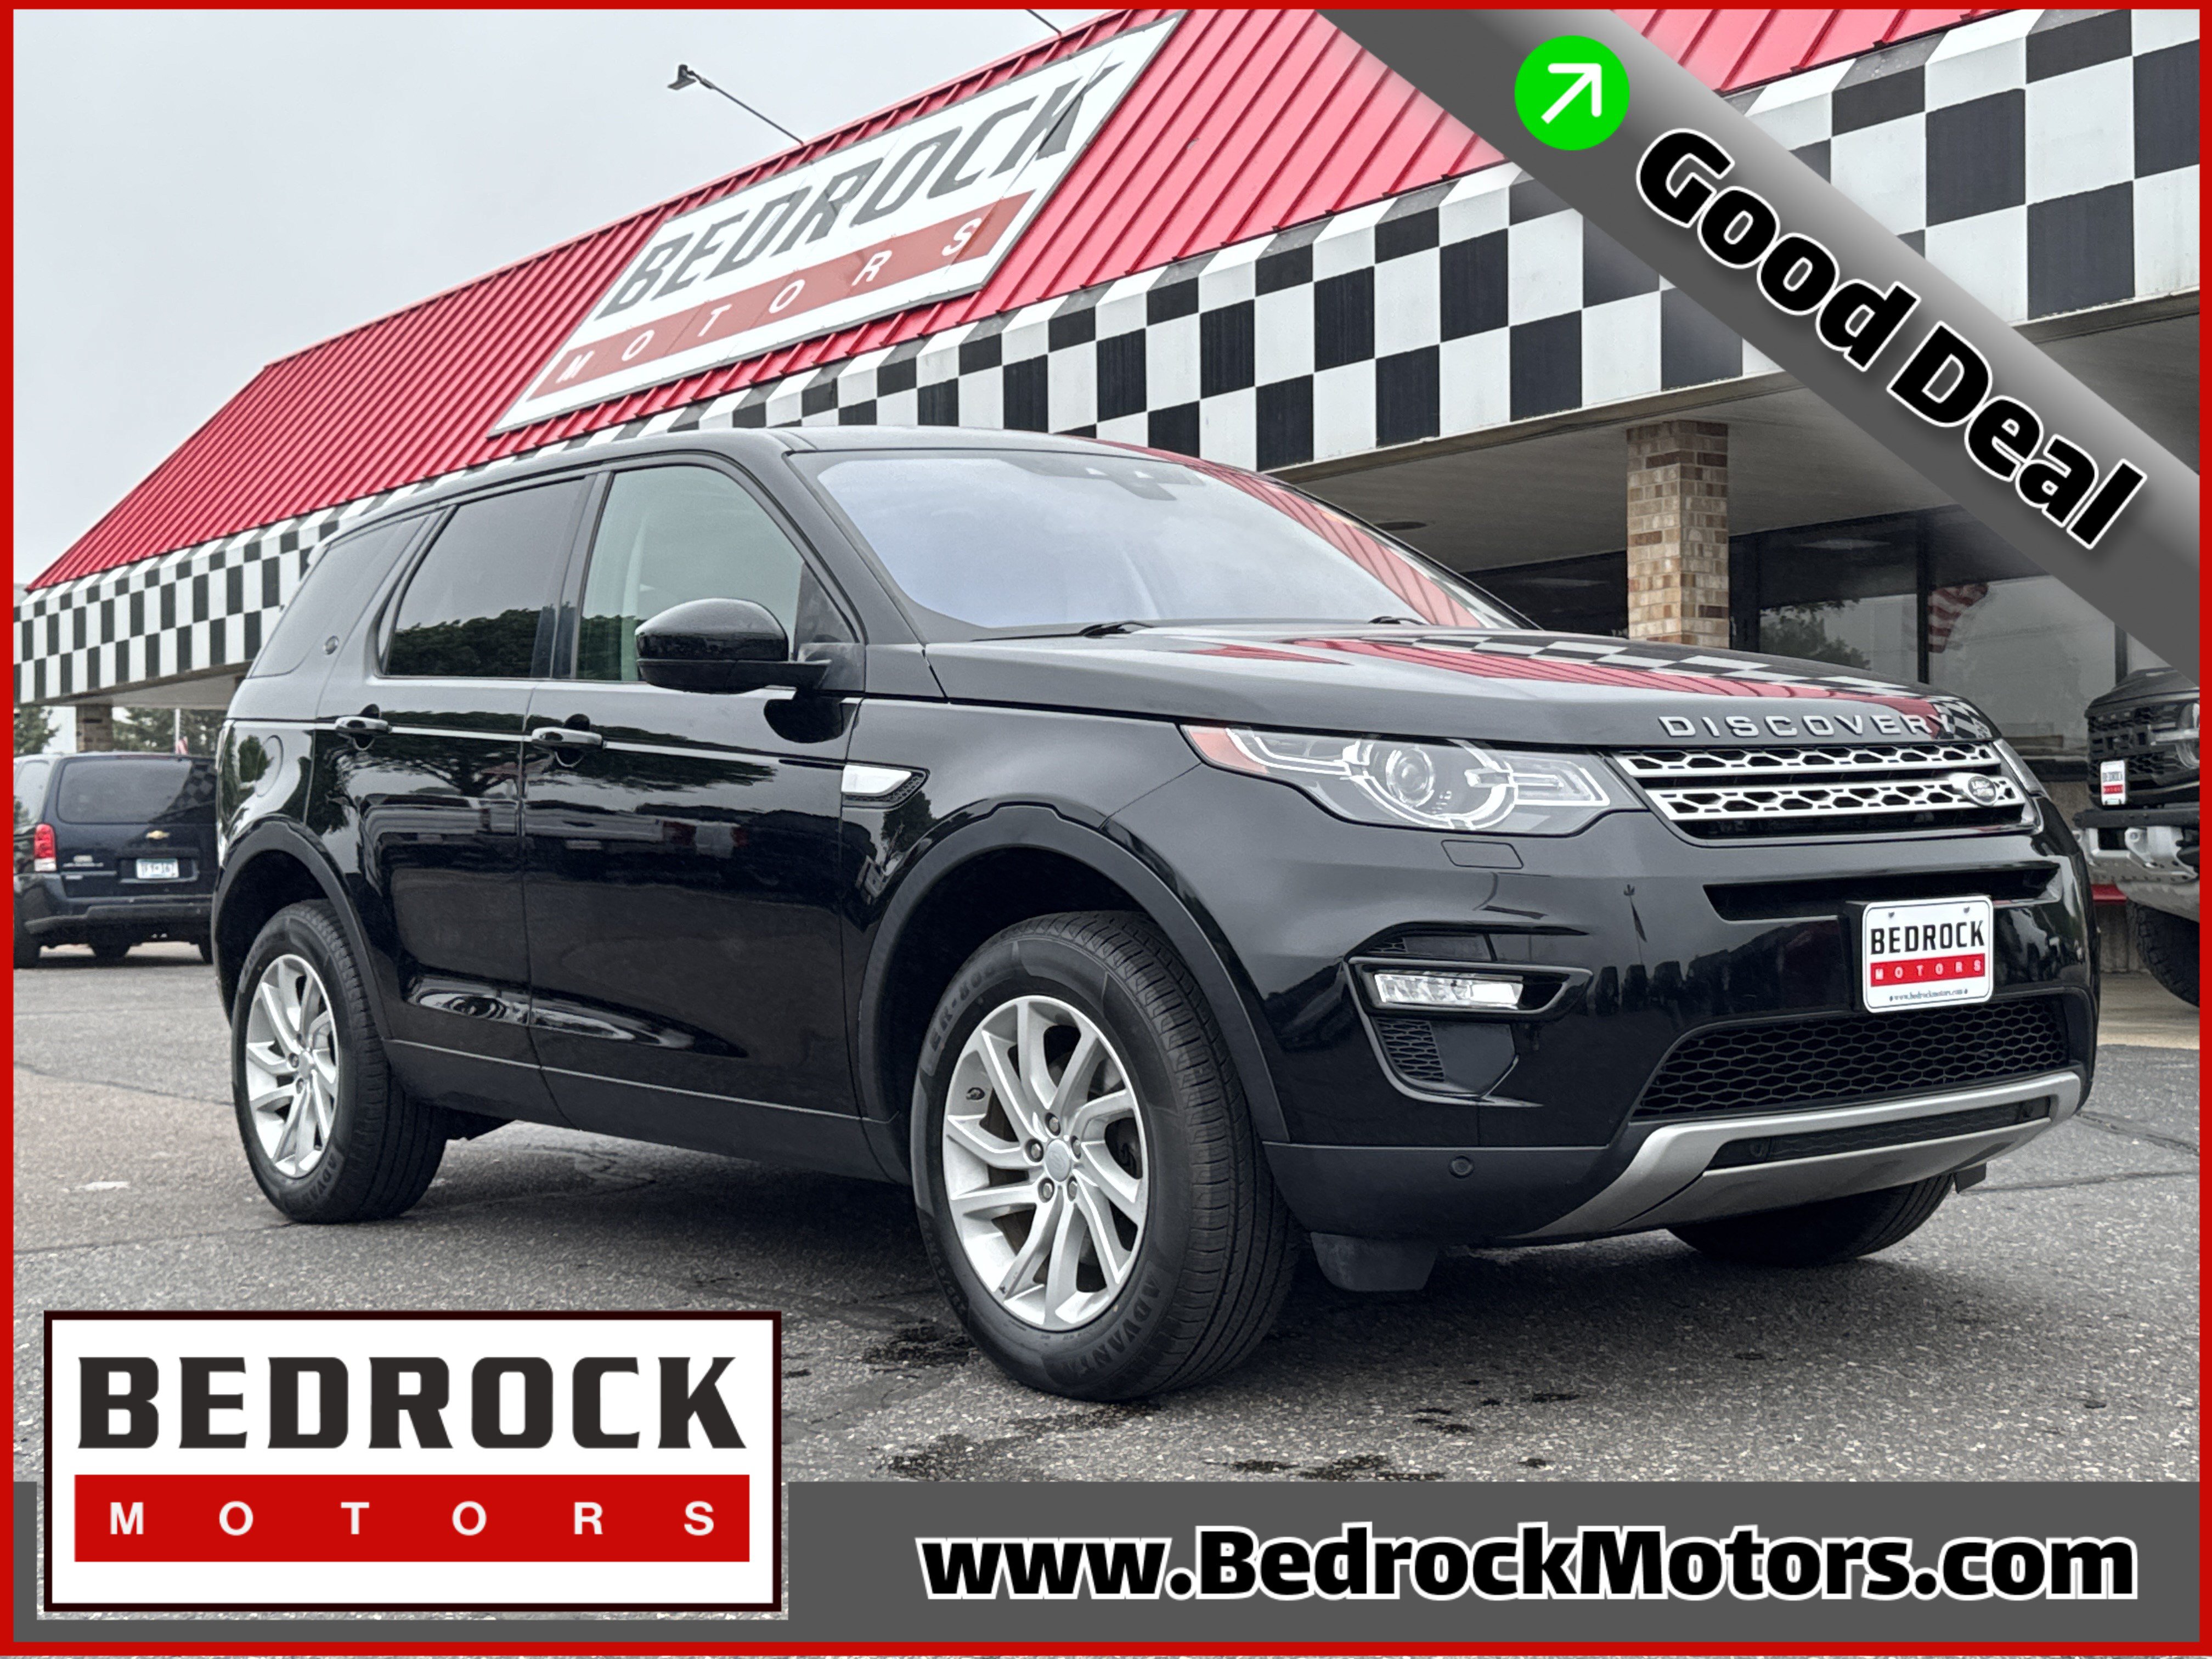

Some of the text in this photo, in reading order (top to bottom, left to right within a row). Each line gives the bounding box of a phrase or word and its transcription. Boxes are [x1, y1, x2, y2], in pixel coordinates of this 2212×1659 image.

[594, 61, 1125, 320] BEDROCK
[556, 217, 981, 383] MOTORS
[1658, 714, 1953, 738] DISCOVERY
[1870, 920, 1985, 955] BEDROCK
[1874, 960, 1982, 980] MOTORS
